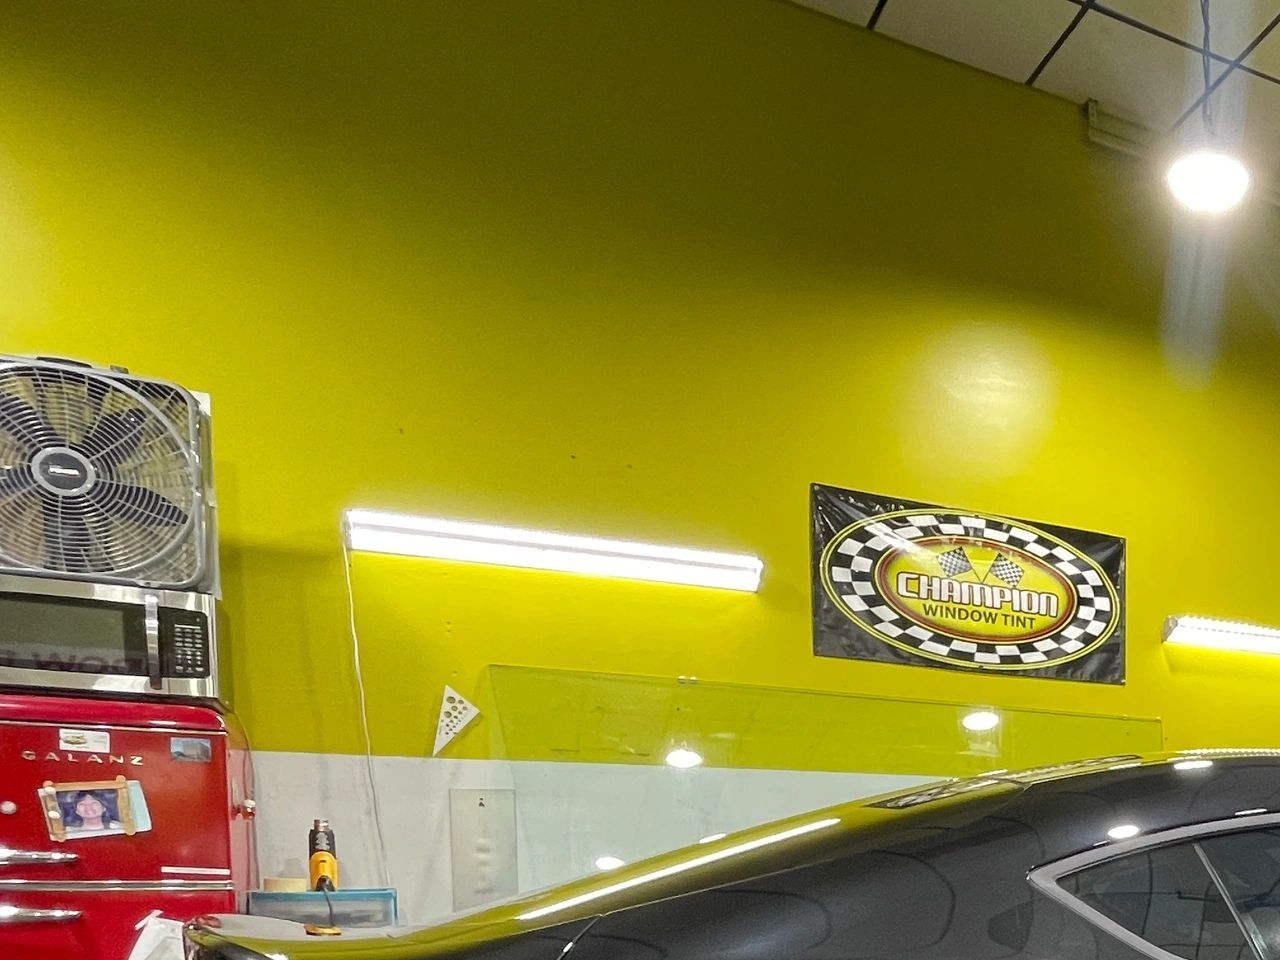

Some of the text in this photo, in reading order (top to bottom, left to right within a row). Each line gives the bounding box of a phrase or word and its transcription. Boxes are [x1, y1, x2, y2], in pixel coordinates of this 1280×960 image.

[896, 571, 1059, 618] CHAMPION
[922, 603, 1037, 630] WINDOW TINT
[21, 750, 145, 766] GALANZ
